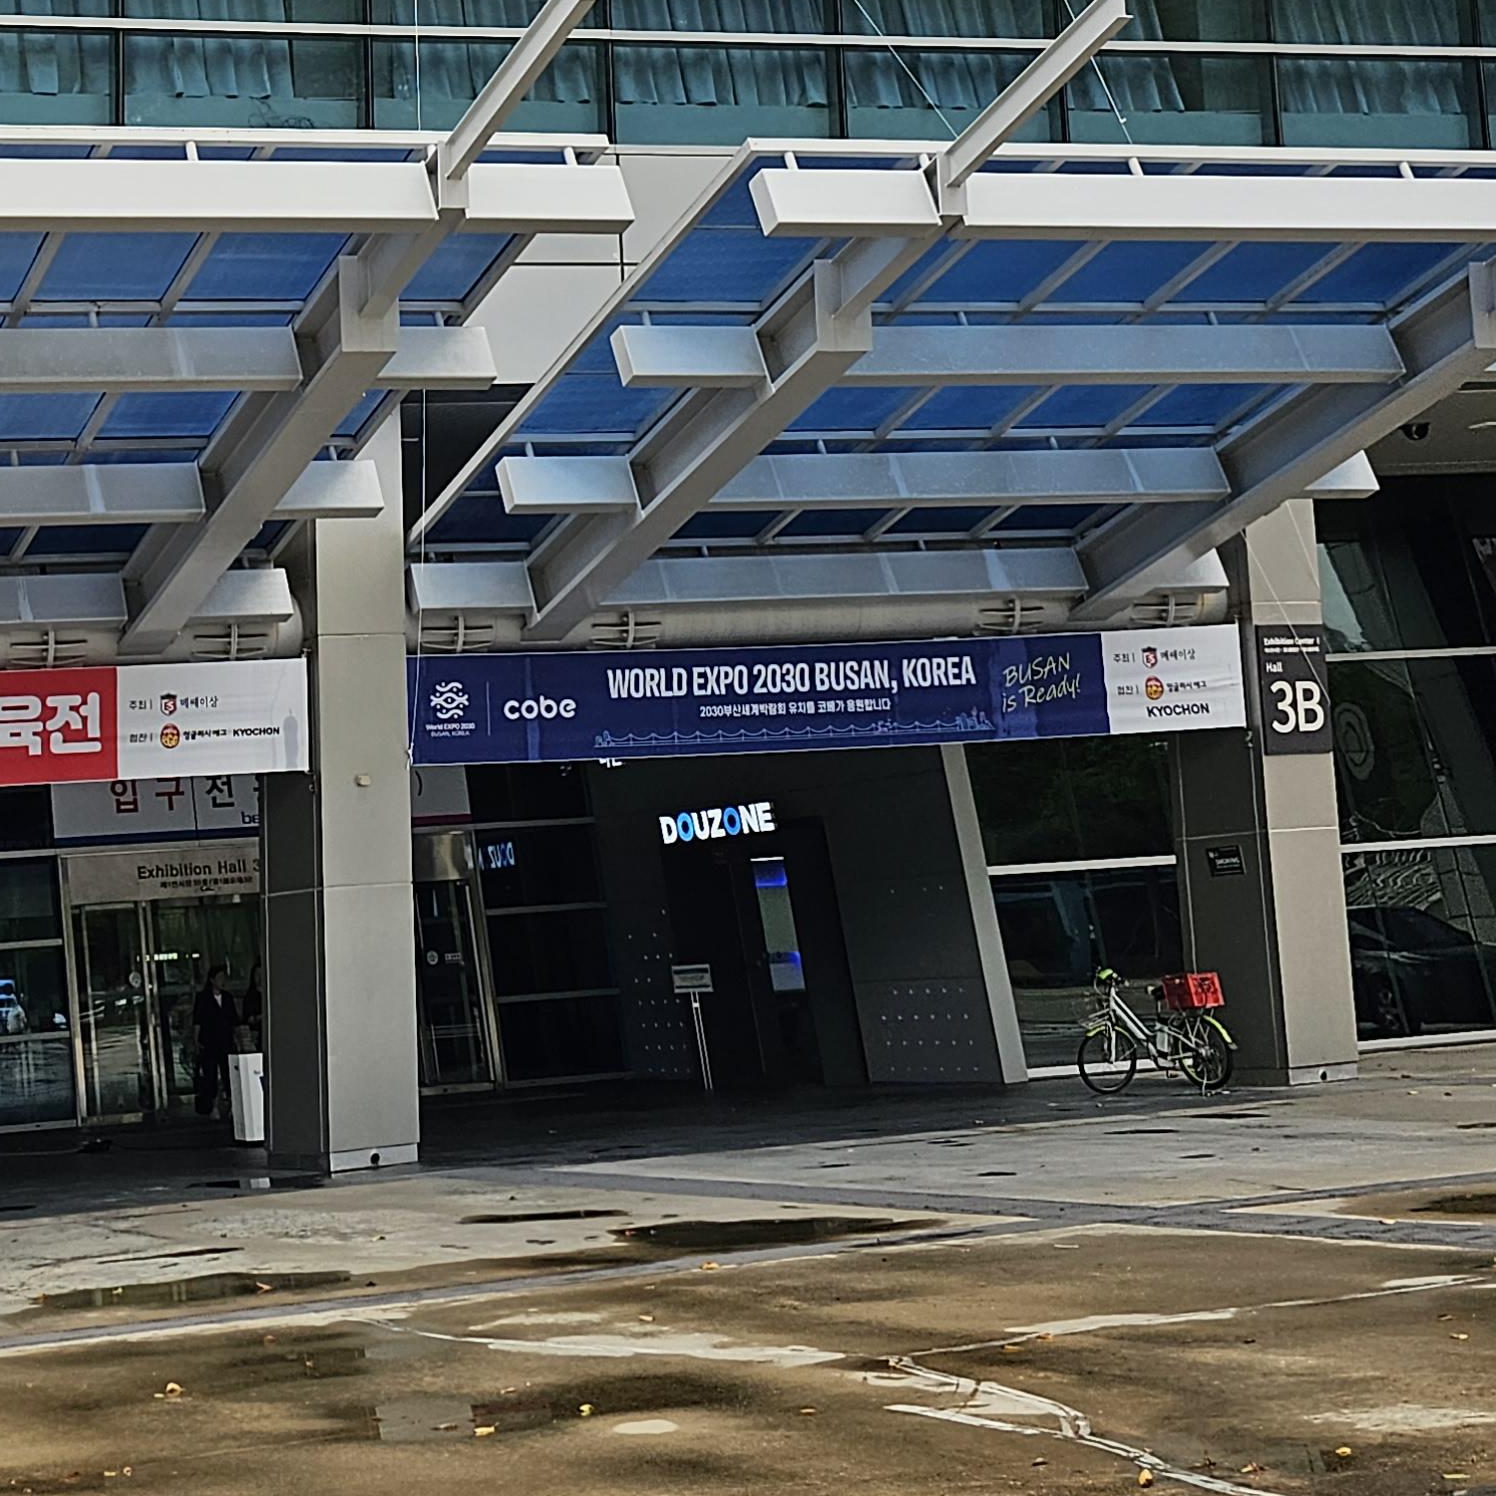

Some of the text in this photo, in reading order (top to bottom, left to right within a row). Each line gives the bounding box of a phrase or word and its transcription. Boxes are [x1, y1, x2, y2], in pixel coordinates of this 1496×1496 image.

[607, 655, 977, 699] WORLD EXPO 2030 BUSAN, KOREA
[1002, 652, 1071, 688] BUSAN
[1265, 661, 1284, 673] Hall
[503, 694, 577, 720] cobe
[1001, 673, 1081, 713] is Ready!
[1270, 680, 1325, 734] 3B
[1146, 703, 1211, 718] KYOCHON
[232, 726, 280, 737] KYOCHON
[658, 801, 776, 845] DOUZONE
[137, 862, 212, 880] Exhibition
[217, 859, 247, 875] Hall
